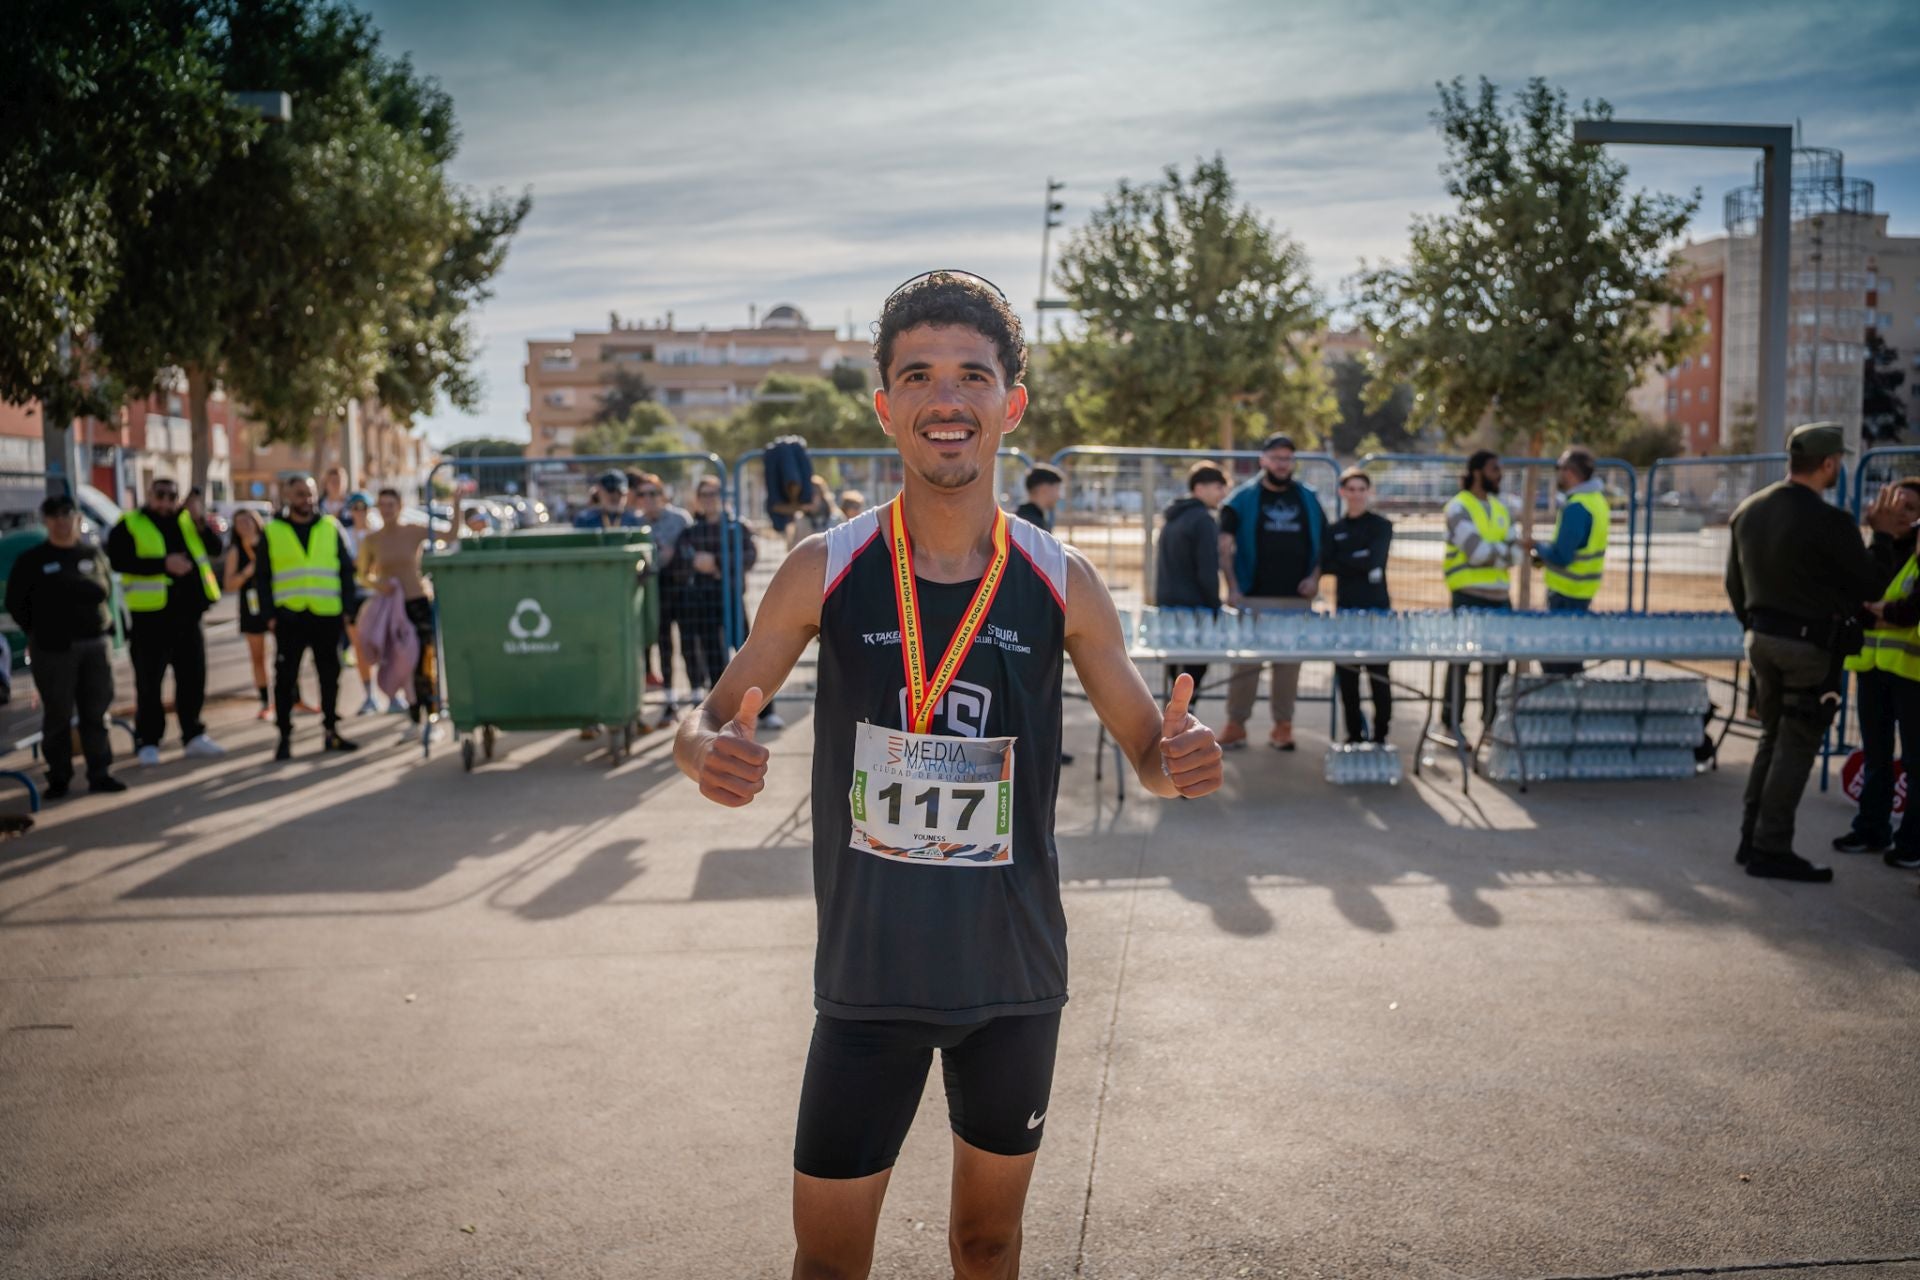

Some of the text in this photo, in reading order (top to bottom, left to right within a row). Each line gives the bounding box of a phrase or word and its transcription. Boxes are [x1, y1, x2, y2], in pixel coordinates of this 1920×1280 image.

[897, 538, 905, 560] MEDIA
[905, 604, 915, 637] CIUDAD
[952, 626, 971, 657] CIUDAD
[968, 584, 992, 625] ROQUETAS
[988, 573, 998, 584] DE
[875, 630, 902, 642] TAKE
[910, 640, 920, 686] ROQUETAS
[914, 689, 922, 701] DE
[903, 739, 967, 763] MEDIA
[872, 763, 912, 777] CIUDAD
[878, 782, 985, 831] 117
[913, 833, 946, 842] YOUNESS
